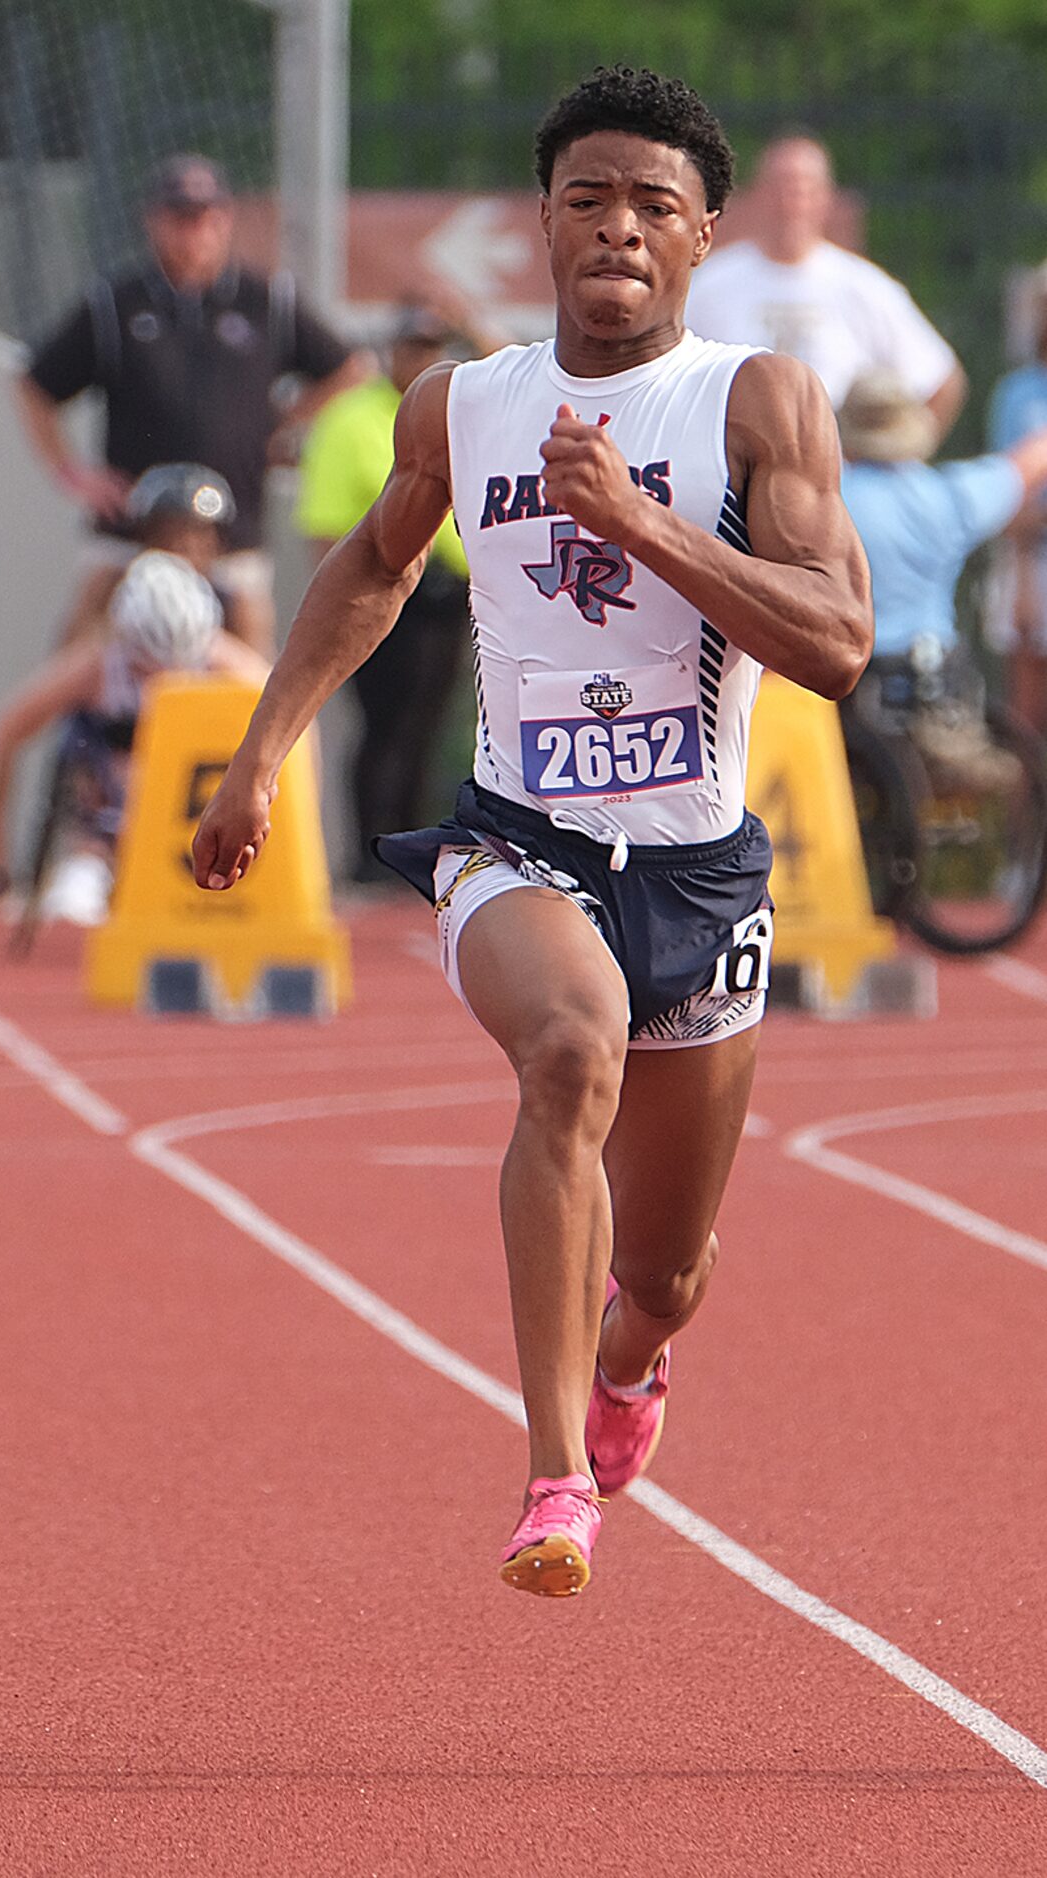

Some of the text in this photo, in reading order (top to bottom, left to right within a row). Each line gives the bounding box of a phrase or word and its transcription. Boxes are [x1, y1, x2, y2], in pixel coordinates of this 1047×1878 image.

[582, 690, 631, 704] STATE
[537, 716, 688, 789] 2652
[602, 794, 632, 805] 2023
